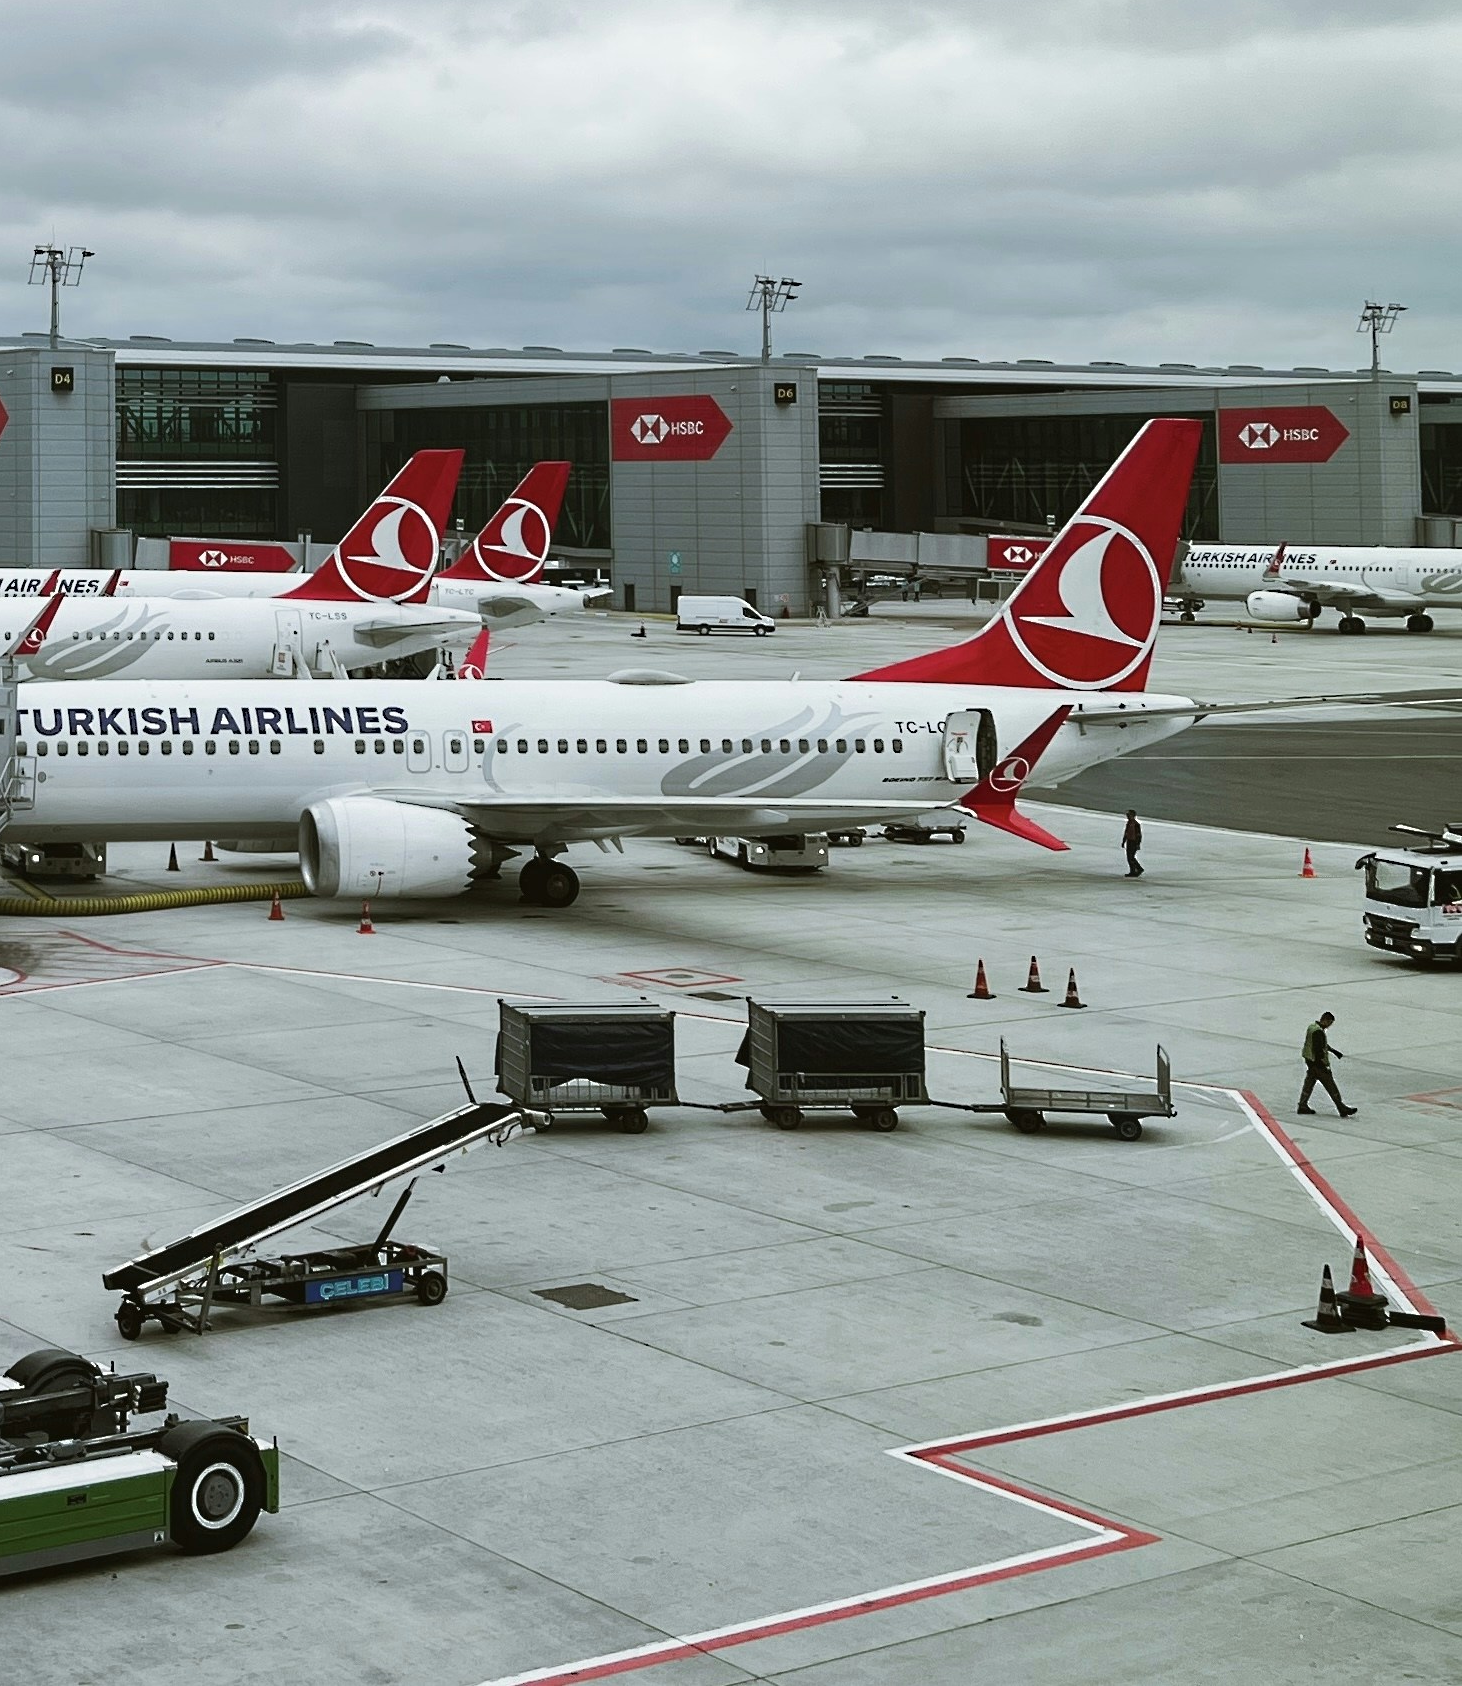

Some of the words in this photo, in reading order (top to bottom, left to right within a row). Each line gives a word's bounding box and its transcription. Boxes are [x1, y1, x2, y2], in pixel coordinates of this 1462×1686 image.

[54, 373, 71, 385] D4
[777, 388, 794, 399] D6
[670, 420, 704, 435] HSBC
[1283, 428, 1319, 441] HSBC
[229, 555, 255, 565] HSBC
[4, 578, 100, 593] AIRNES
[16, 707, 201, 737] TURKISH
[210, 706, 409, 735] AIRLINES
[894, 721, 947, 734] TC-LC
